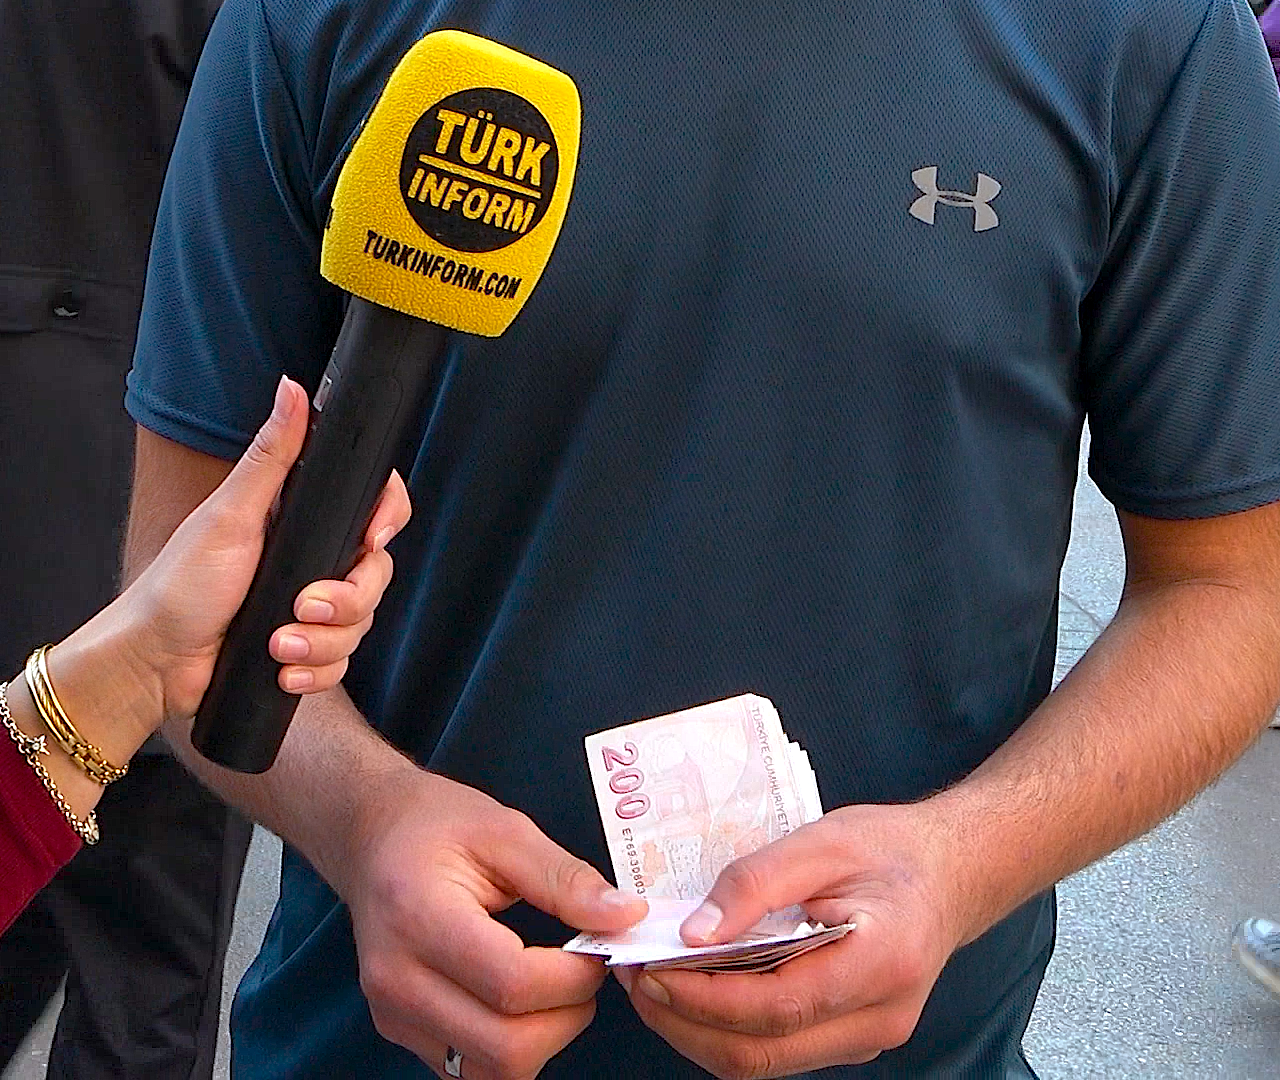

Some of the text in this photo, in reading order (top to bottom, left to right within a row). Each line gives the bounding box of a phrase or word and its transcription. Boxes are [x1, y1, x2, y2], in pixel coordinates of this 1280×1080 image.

[436, 109, 551, 187] TÜRK
[407, 167, 538, 234] INFORM
[363, 229, 522, 299] TURKINFORM.COM
[601, 741, 652, 820] 200
